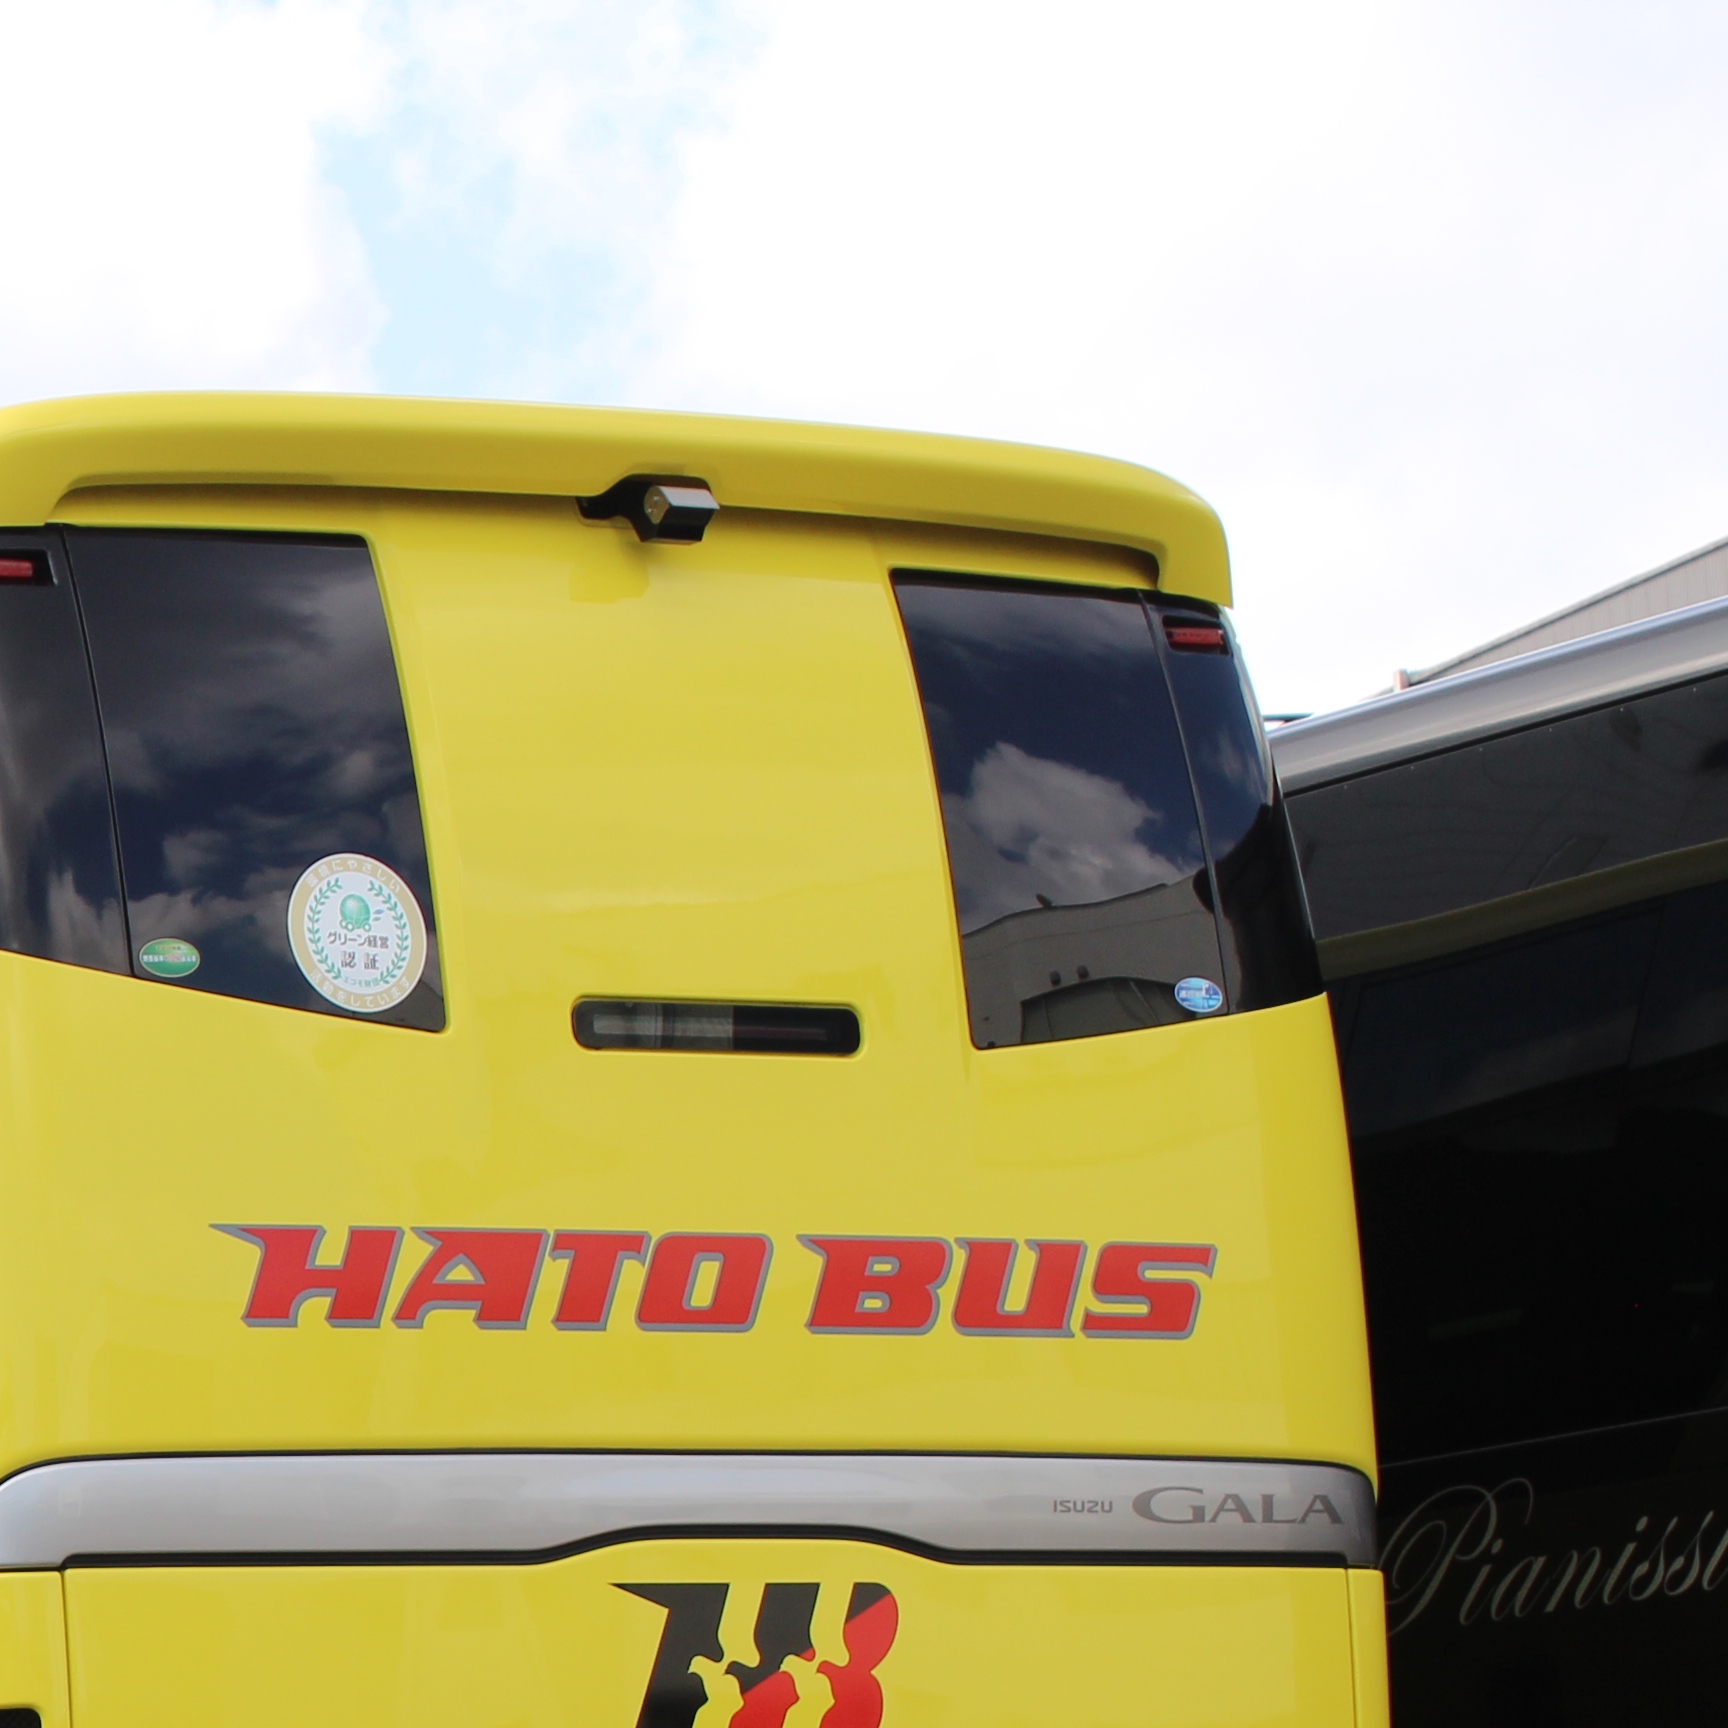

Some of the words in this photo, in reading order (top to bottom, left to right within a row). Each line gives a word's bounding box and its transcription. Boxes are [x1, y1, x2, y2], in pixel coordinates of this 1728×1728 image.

[327, 931, 390, 949] グリーン経営
[208, 1222, 773, 1334] HATO
[796, 1232, 1217, 1340] BUS
[1053, 1499, 1113, 1513] ISUZU
[1132, 1486, 1344, 1524] GALA
